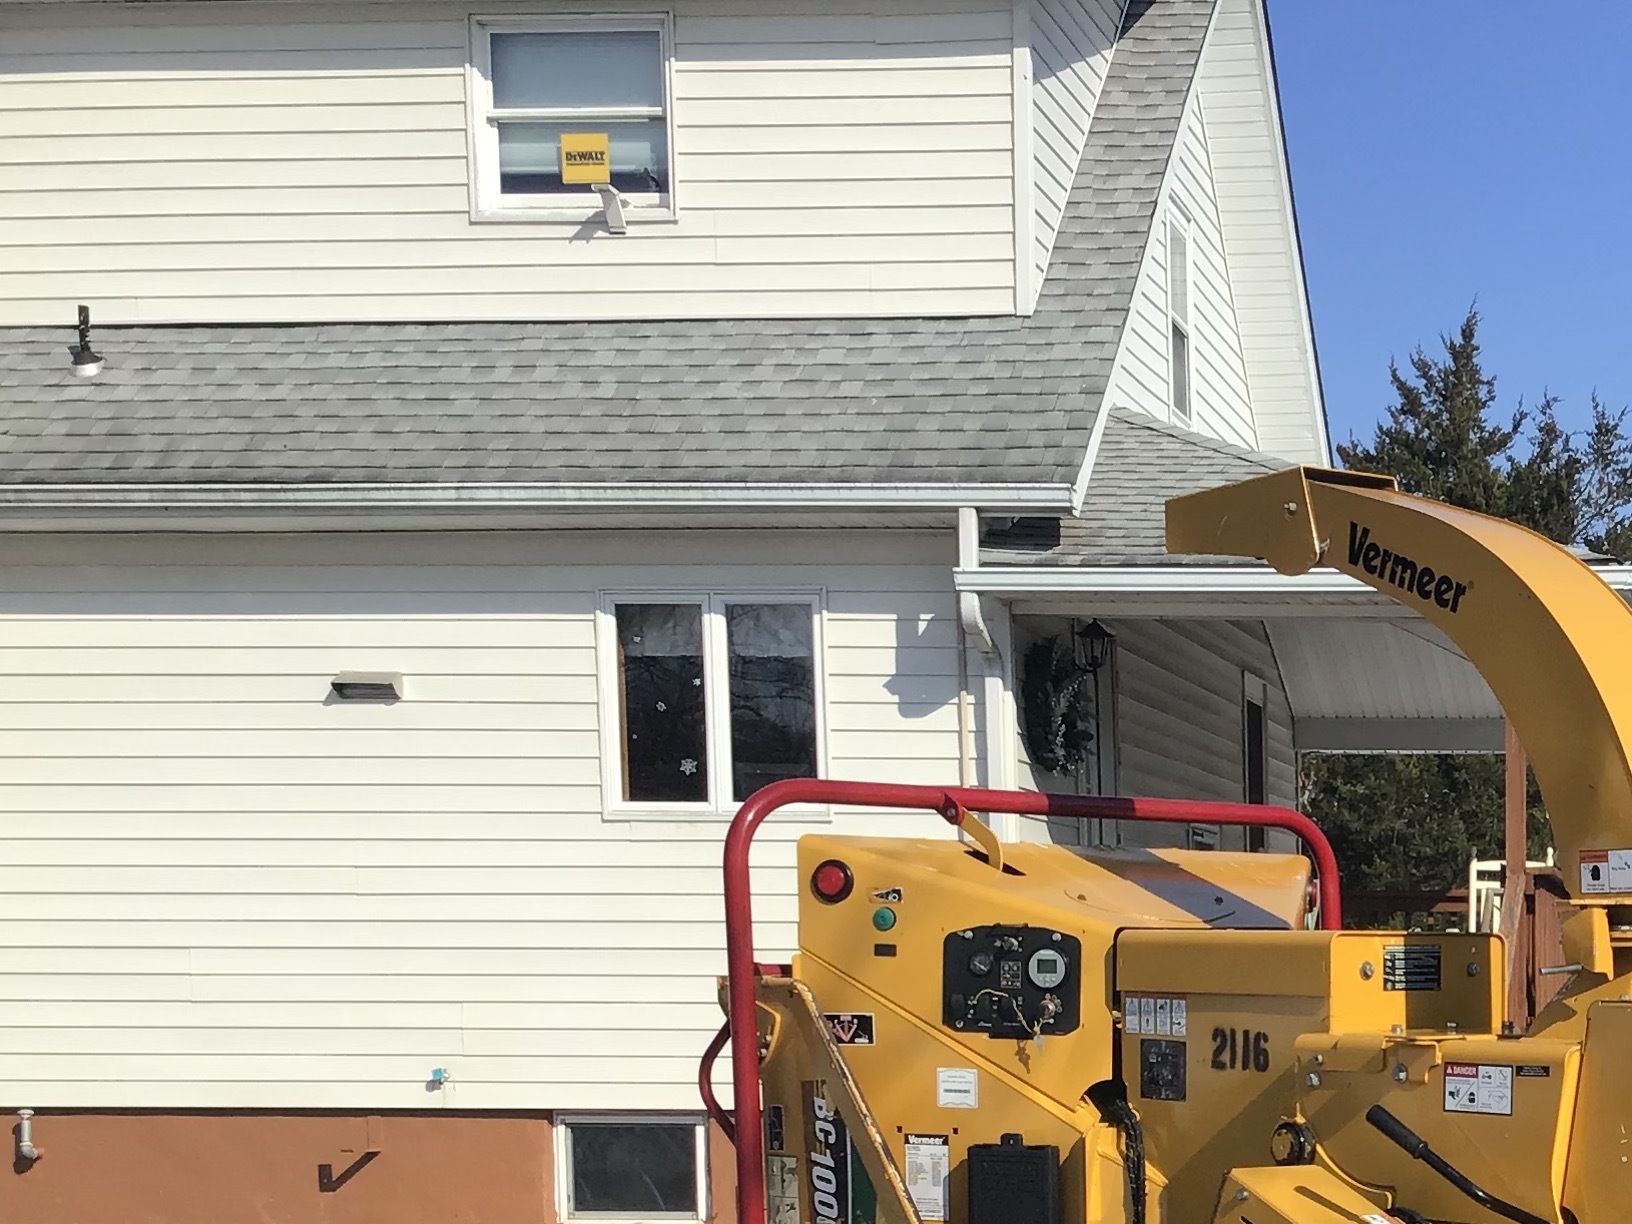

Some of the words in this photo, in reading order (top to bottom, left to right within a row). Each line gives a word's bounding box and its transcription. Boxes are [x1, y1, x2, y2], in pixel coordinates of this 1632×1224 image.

[1348, 521, 1467, 613] Vermeer
[1211, 1027, 1269, 1072] 2116
[1453, 1066, 1477, 1075] DANGER
[908, 1135, 943, 1145] Vermeer
